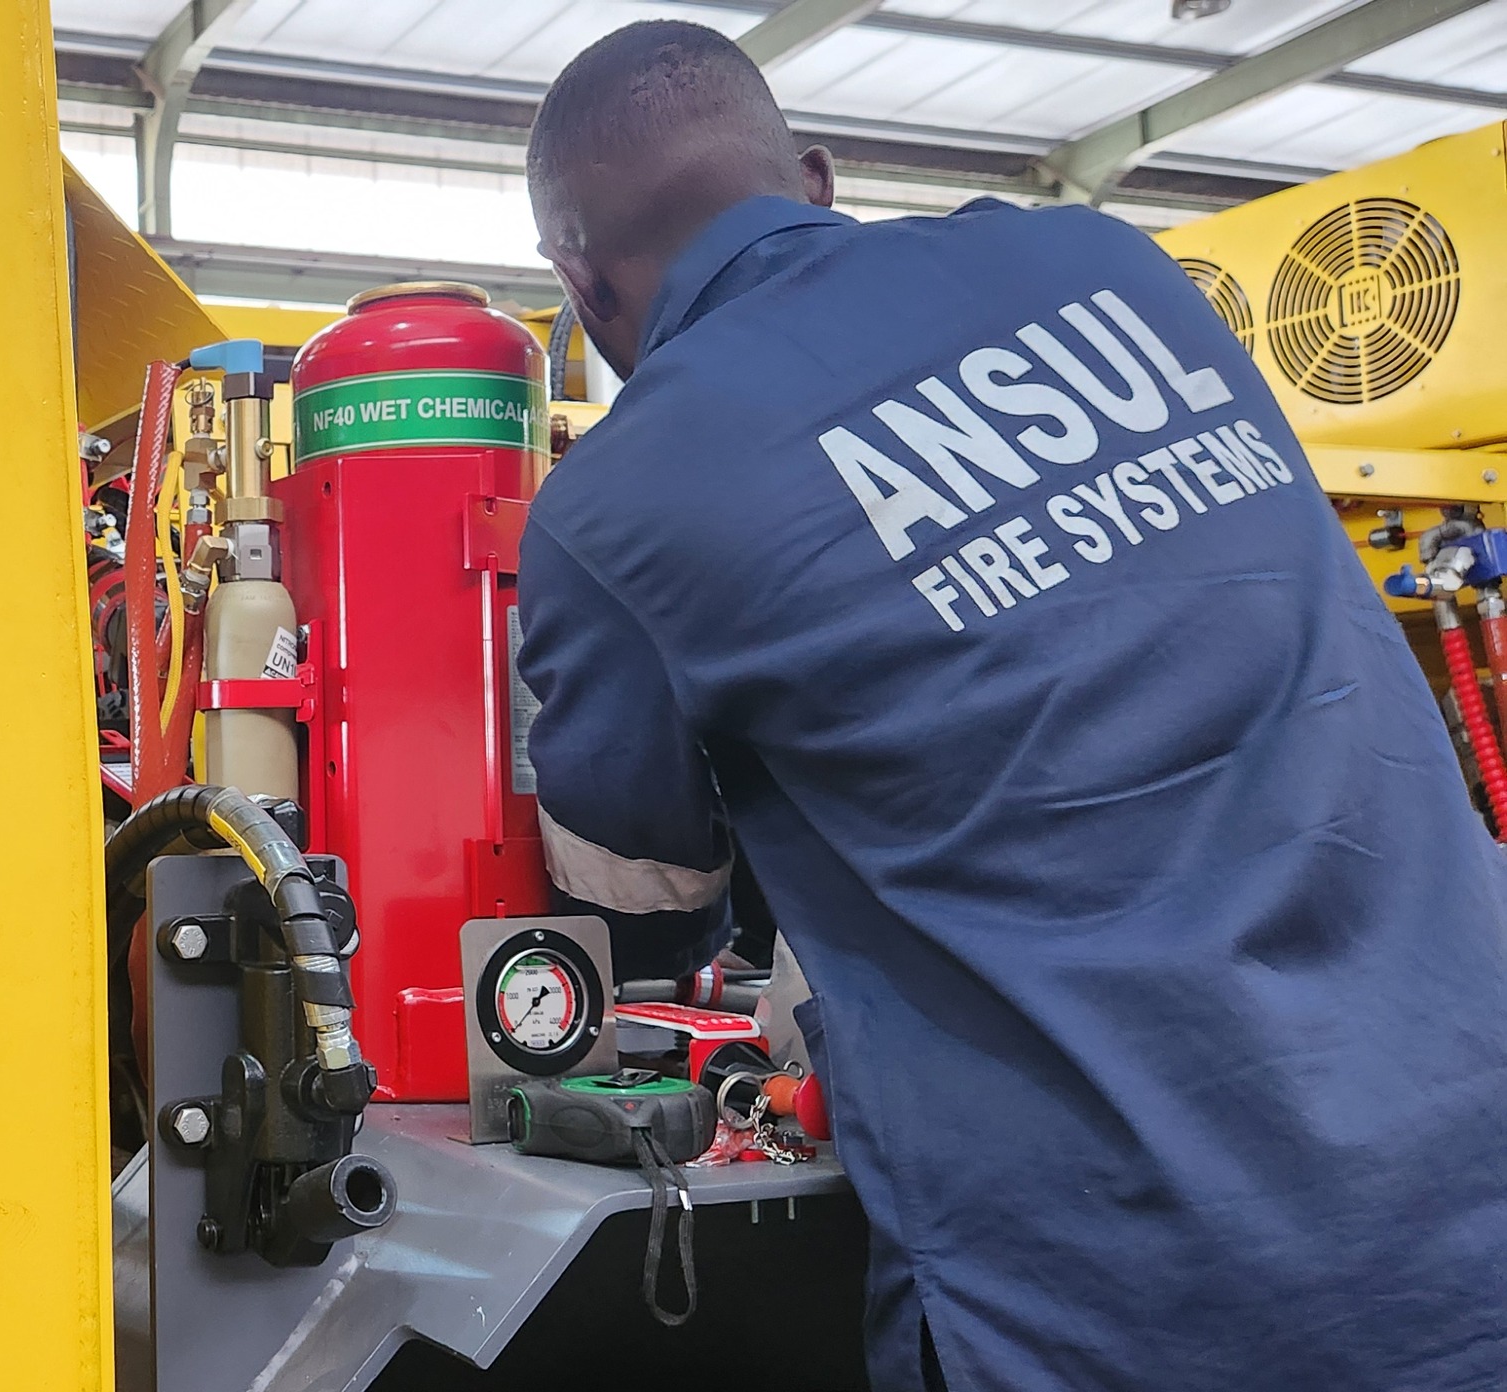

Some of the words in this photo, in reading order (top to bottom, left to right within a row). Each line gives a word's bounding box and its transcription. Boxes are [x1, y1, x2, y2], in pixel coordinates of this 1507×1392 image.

[313, 405, 356, 432] NF40
[360, 398, 411, 424] WET
[417, 397, 525, 424] CHEMICAL
[817, 288, 1235, 562] ANSUL
[910, 515, 1071, 633] FIRE
[1045, 418, 1294, 564] SYSTEMS
[506, 992, 519, 1000] 1000
